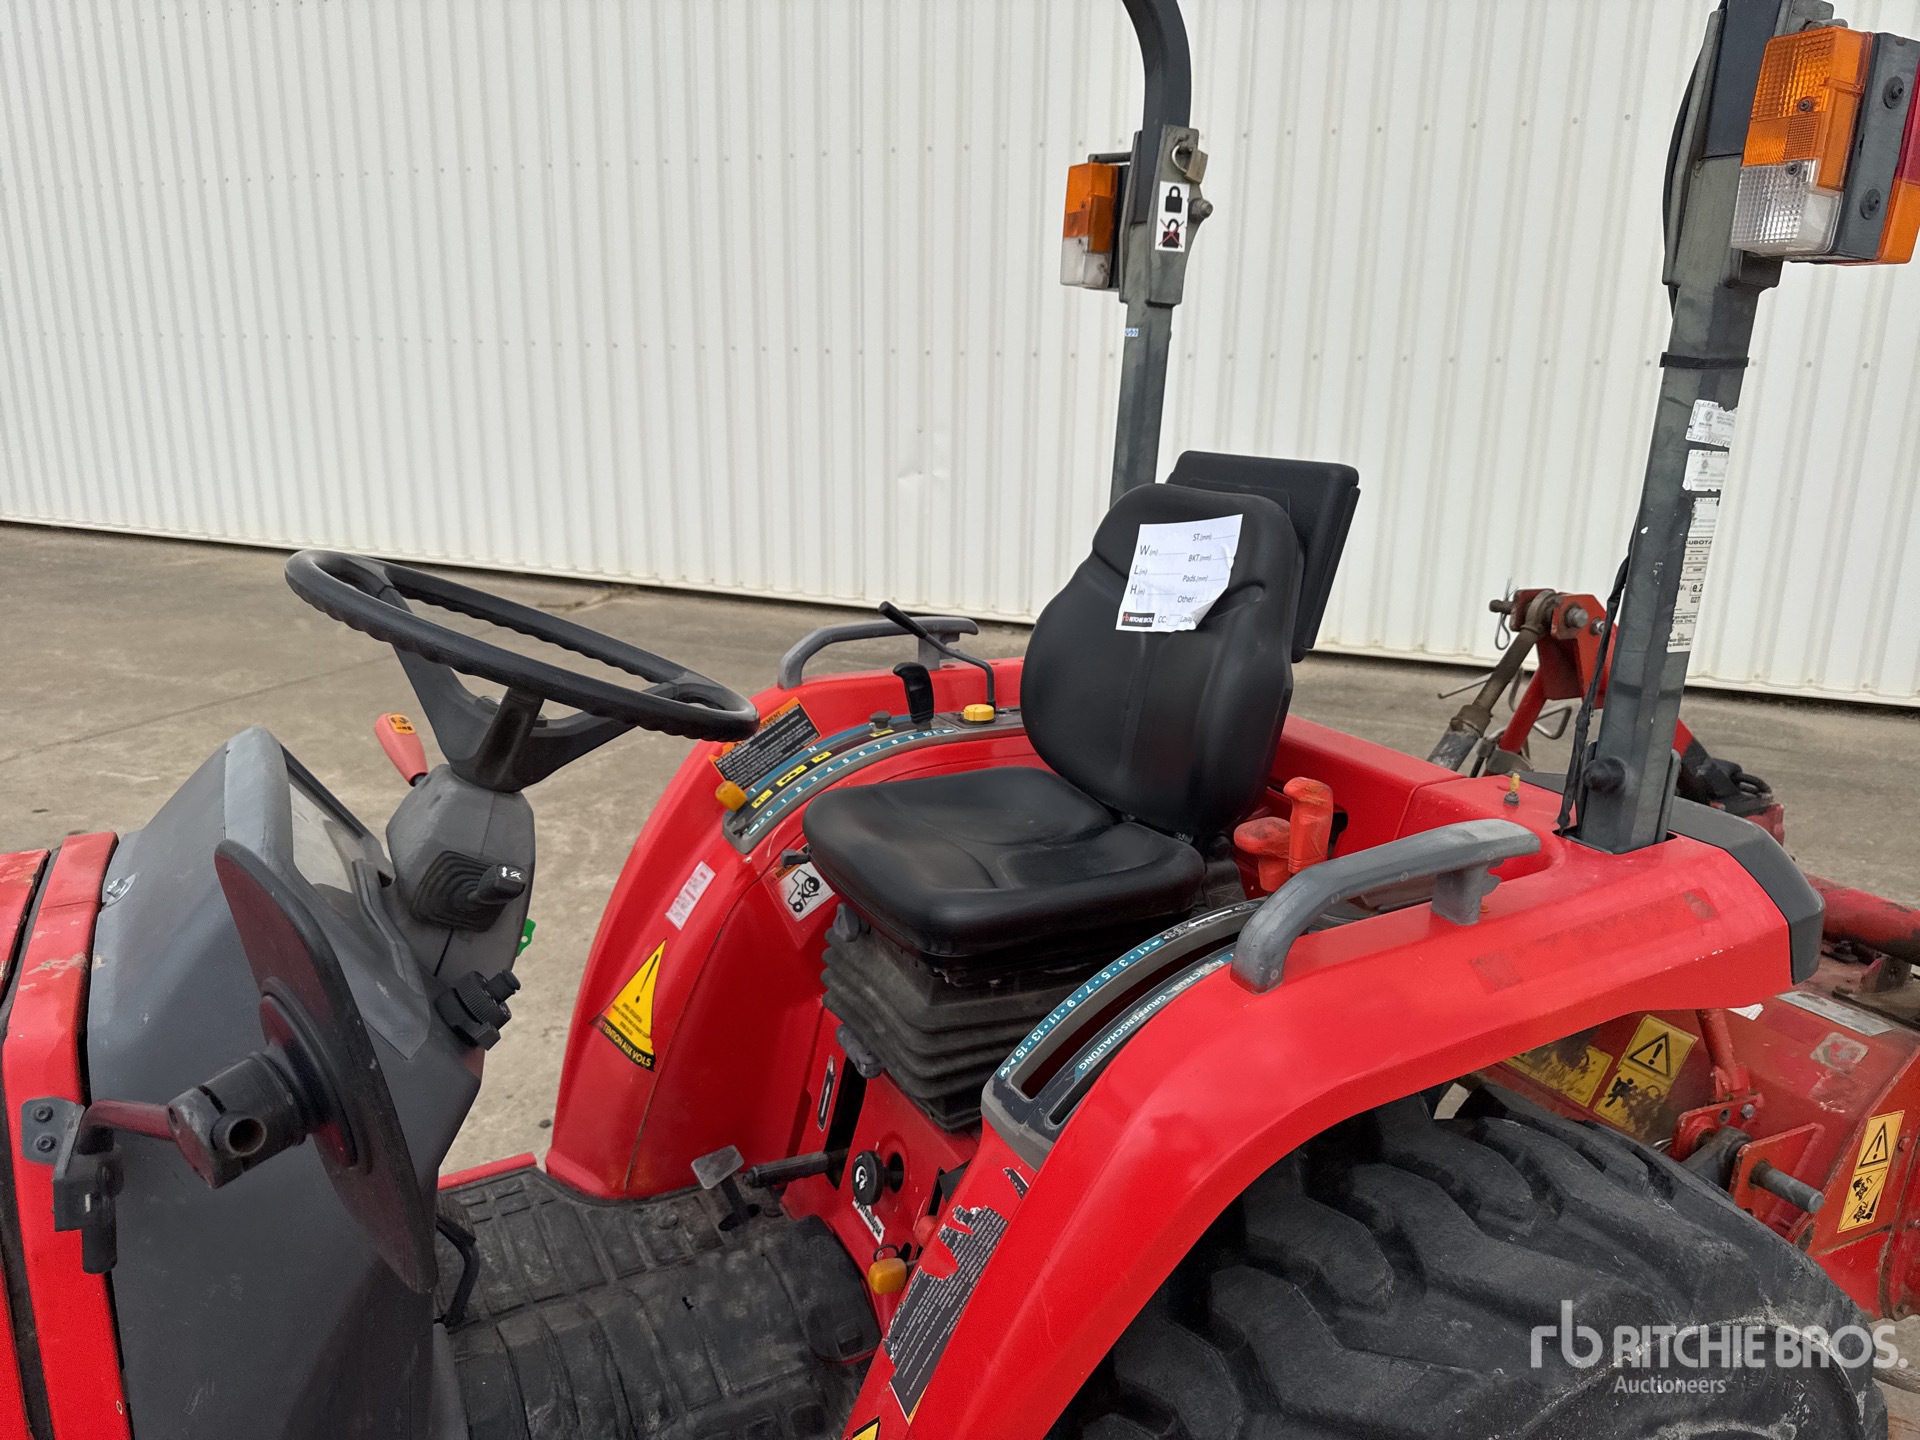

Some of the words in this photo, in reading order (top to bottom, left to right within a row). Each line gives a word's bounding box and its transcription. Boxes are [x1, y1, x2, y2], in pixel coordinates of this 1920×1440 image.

[1118, 959, 1129, 968] 3
[1101, 971, 1111, 980] 5
[1084, 984, 1094, 994] 7
[1031, 1029, 1045, 1042] 13
[1015, 1046, 1029, 1059] 15
[629, 1049, 652, 1068] VOLS
